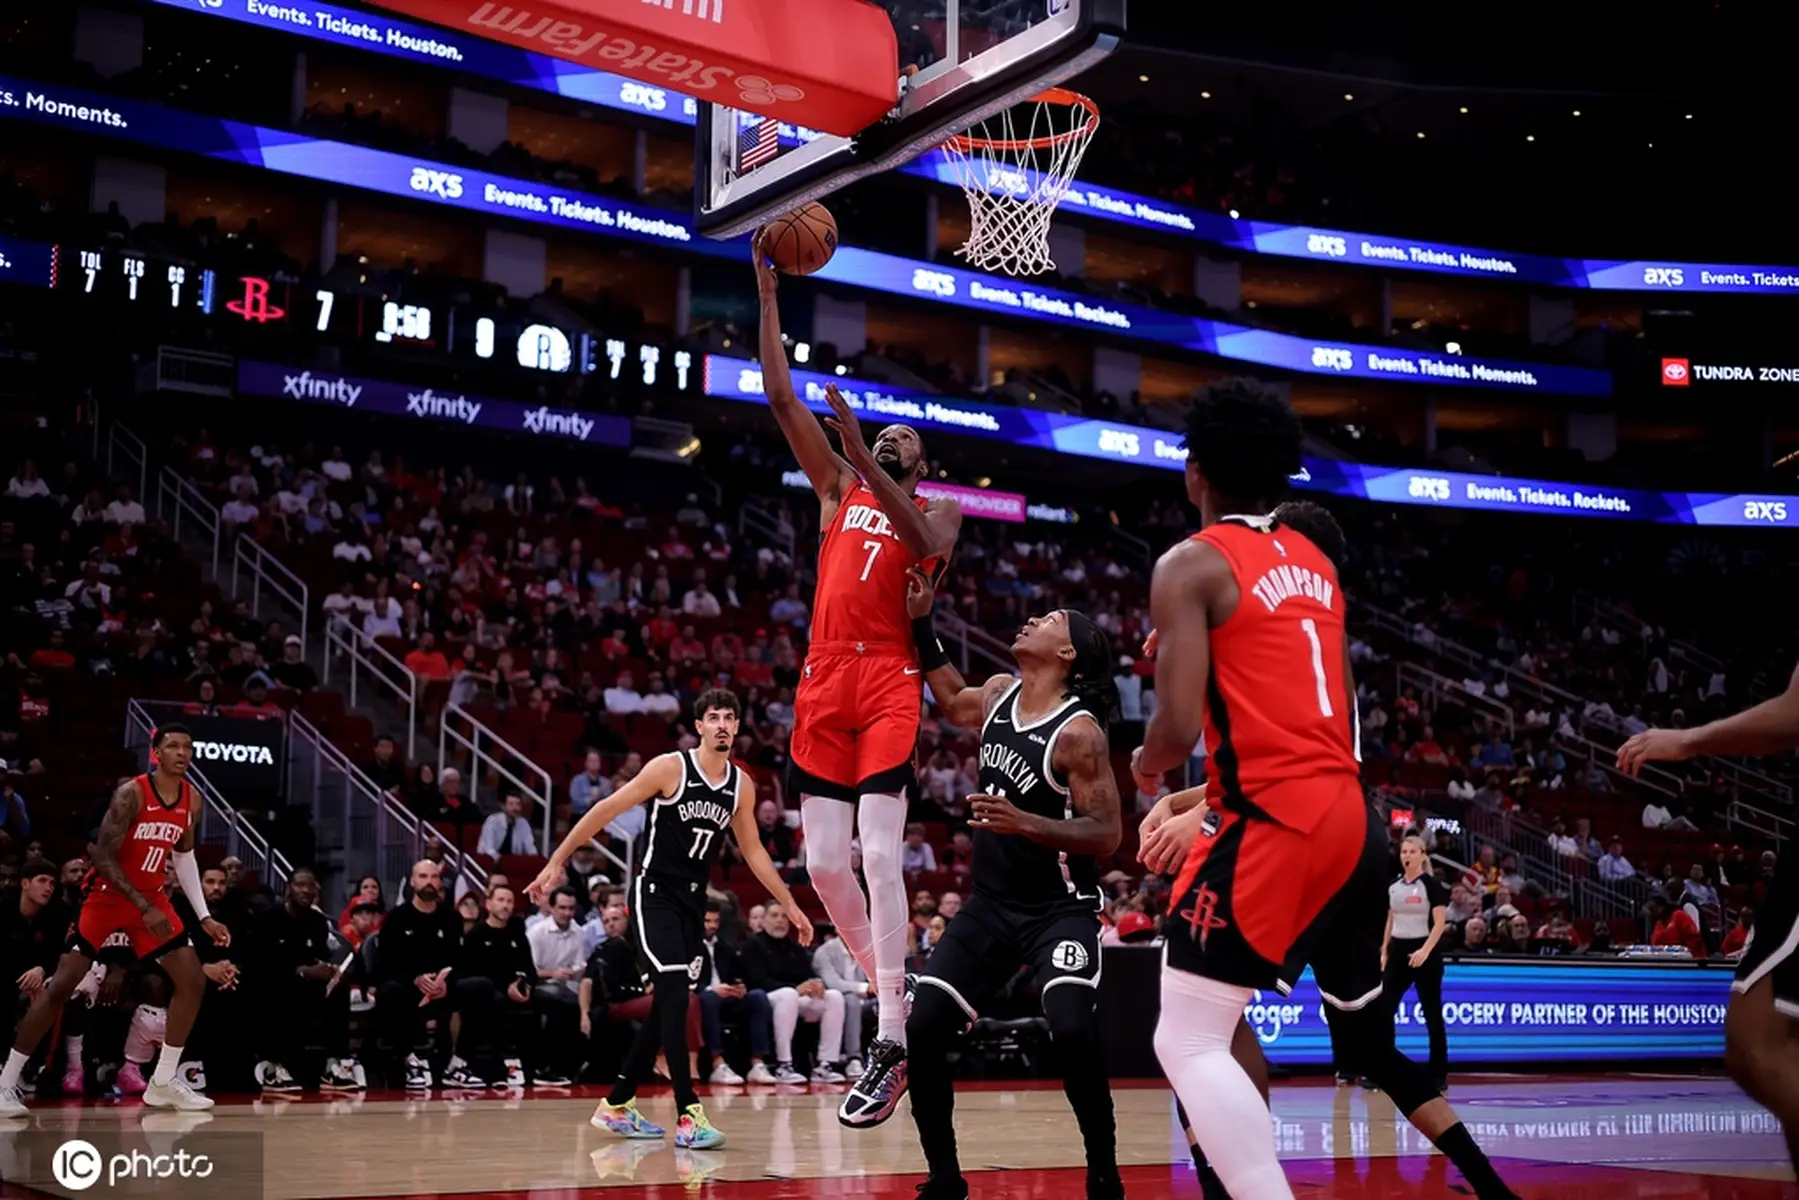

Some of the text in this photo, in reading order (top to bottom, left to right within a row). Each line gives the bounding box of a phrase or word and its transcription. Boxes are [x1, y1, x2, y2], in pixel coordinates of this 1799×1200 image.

[247, 0, 463, 61] Events. Tickets. Houston.
[26, 91, 128, 128] Moments.
[620, 82, 666, 111] axs
[410, 166, 691, 241] axs Events. Tickets. Houston.
[80, 251, 102, 270] TOL
[1307, 234, 1517, 273] axs Events. Tickets. Houston.
[85, 268, 96, 293] 7
[129, 276, 138, 300] 1
[171, 283, 180, 307] 1
[1643, 267, 1684, 288] axs
[1700, 271, 1750, 285] Events.
[316, 290, 334, 331] 7
[1311, 347, 1538, 386] axs Events. Tickets. Moments.
[1693, 365, 1799, 382] TUNDRA ZONE
[283, 371, 362, 407] xfinity
[406, 389, 482, 424] xfinity
[522, 406, 595, 441] xfinity
[1408, 476, 1631, 513] axs Events. Tickets. Rockets.
[1743, 500, 1788, 523] axs
[862, 540, 883, 581] 7
[1251, 564, 1334, 613] THOMPSON
[1301, 618, 1334, 717] 1
[193, 741, 274, 765] TOYOTA
[133, 822, 184, 845] ROCKETS
[688, 827, 715, 860] 77
[140, 845, 164, 873] 10
[1244, 990, 1304, 1043] roger
[1511, 1002, 1586, 1025] PARTNER
[1592, 1003, 1615, 1025] OF
[1620, 1004, 1649, 1025] THE
